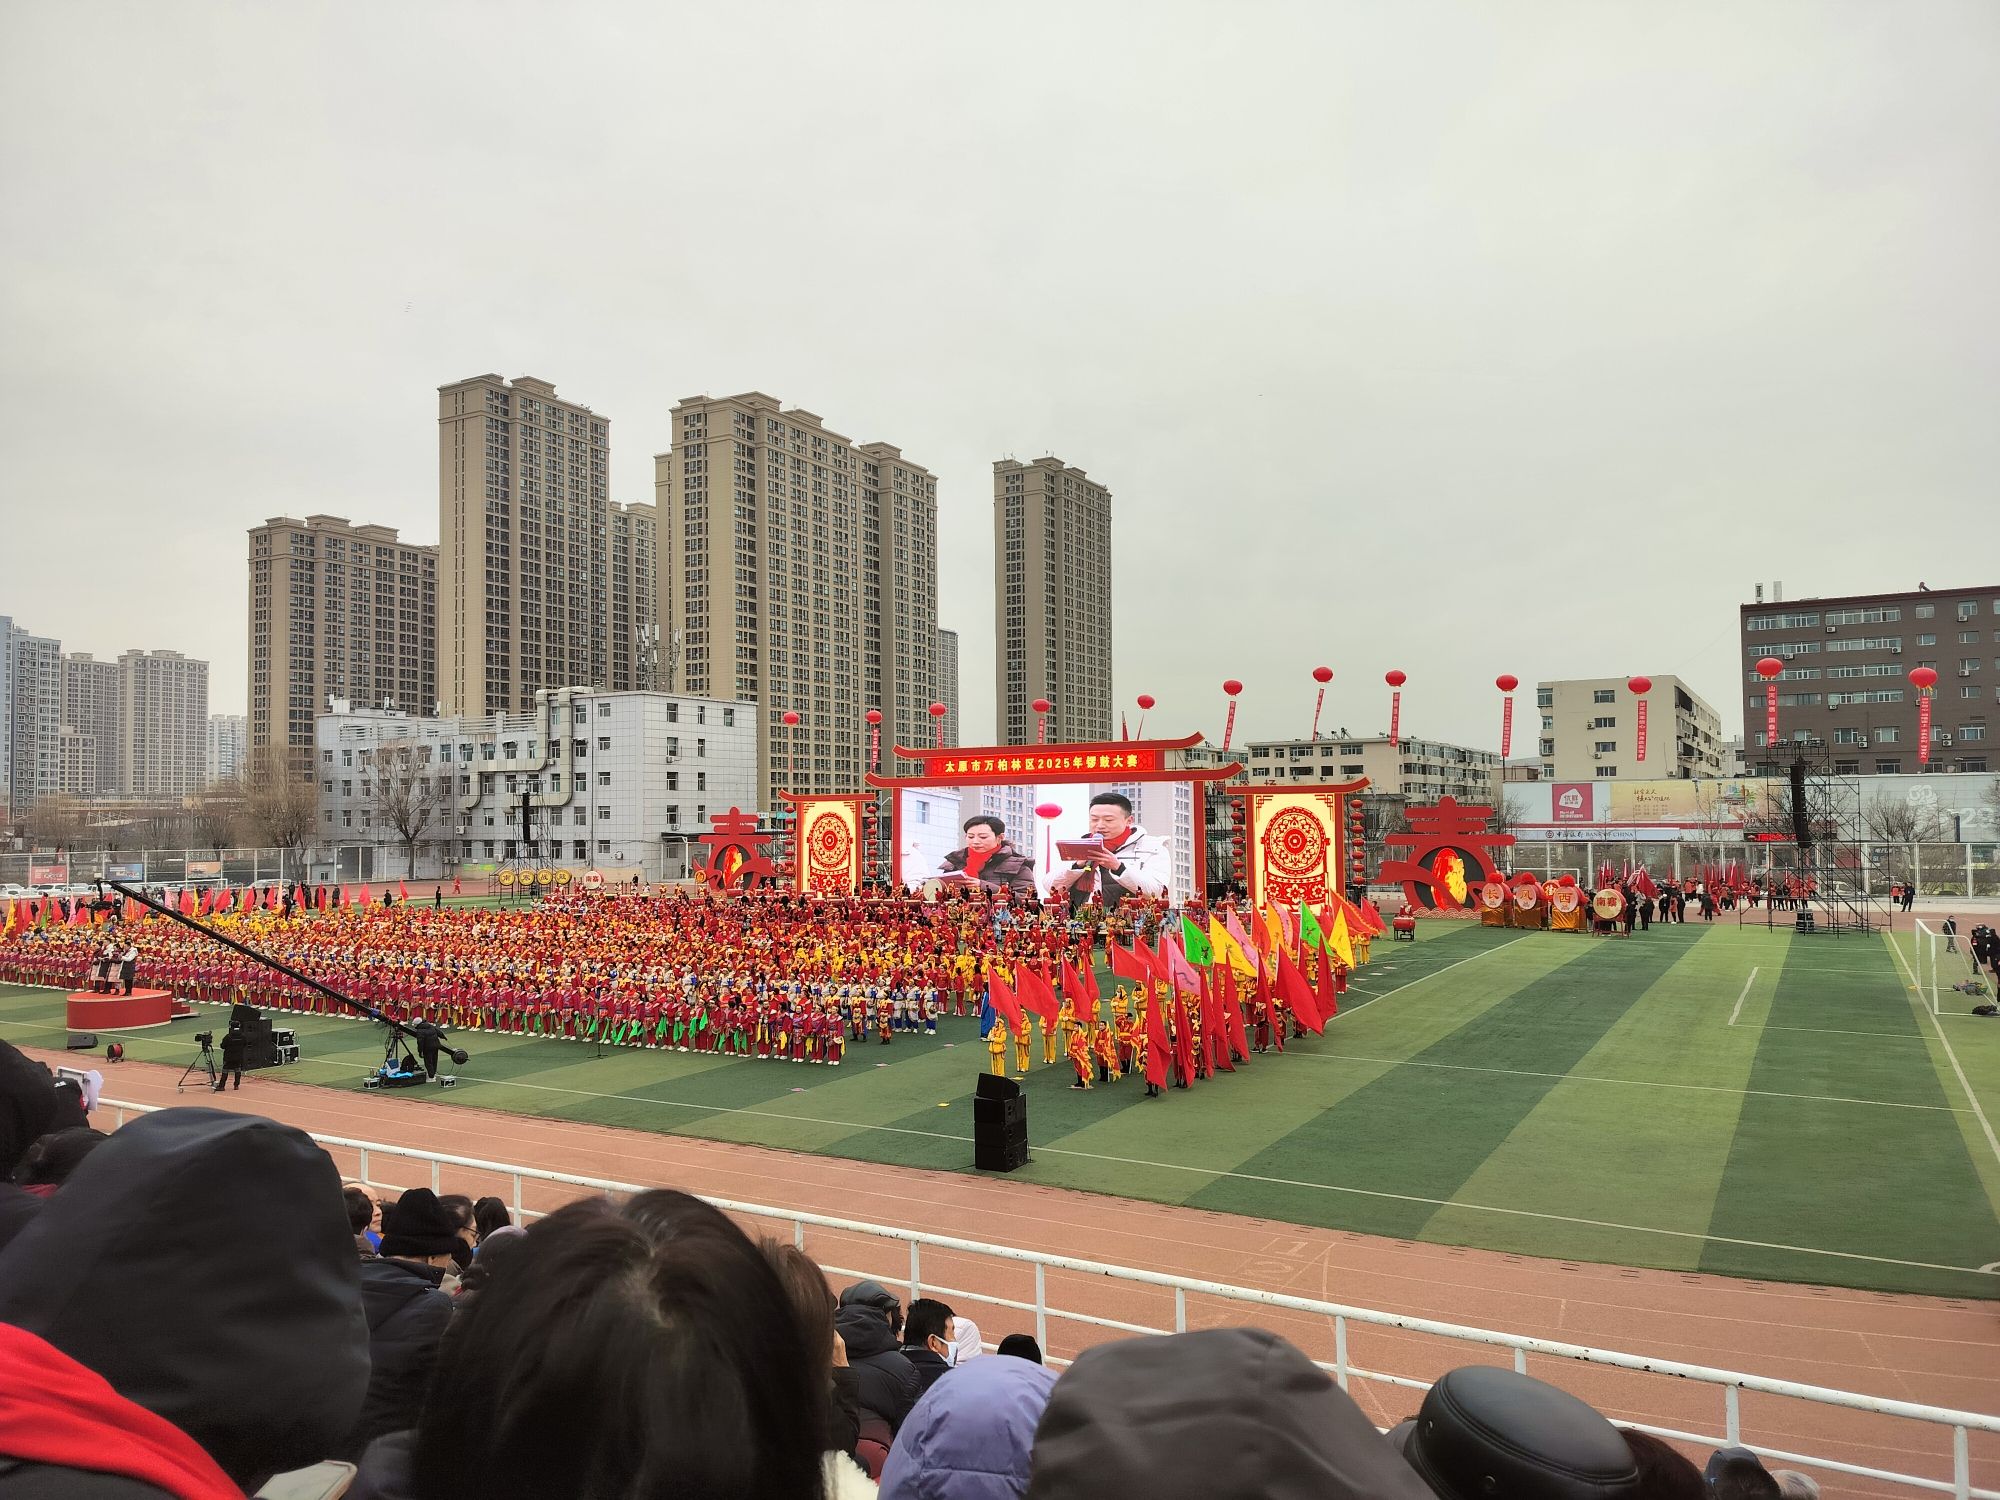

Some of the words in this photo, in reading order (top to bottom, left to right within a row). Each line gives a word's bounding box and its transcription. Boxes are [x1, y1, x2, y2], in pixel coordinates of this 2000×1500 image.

[945, 754, 1138, 773] 太原市万柏林区2025年锣鼓大赛
[1486, 888, 1500, 900] 长
[1519, 889, 1533, 900] 风
[1557, 892, 1573, 904] 西
[1596, 896, 1618, 908] 南寨
